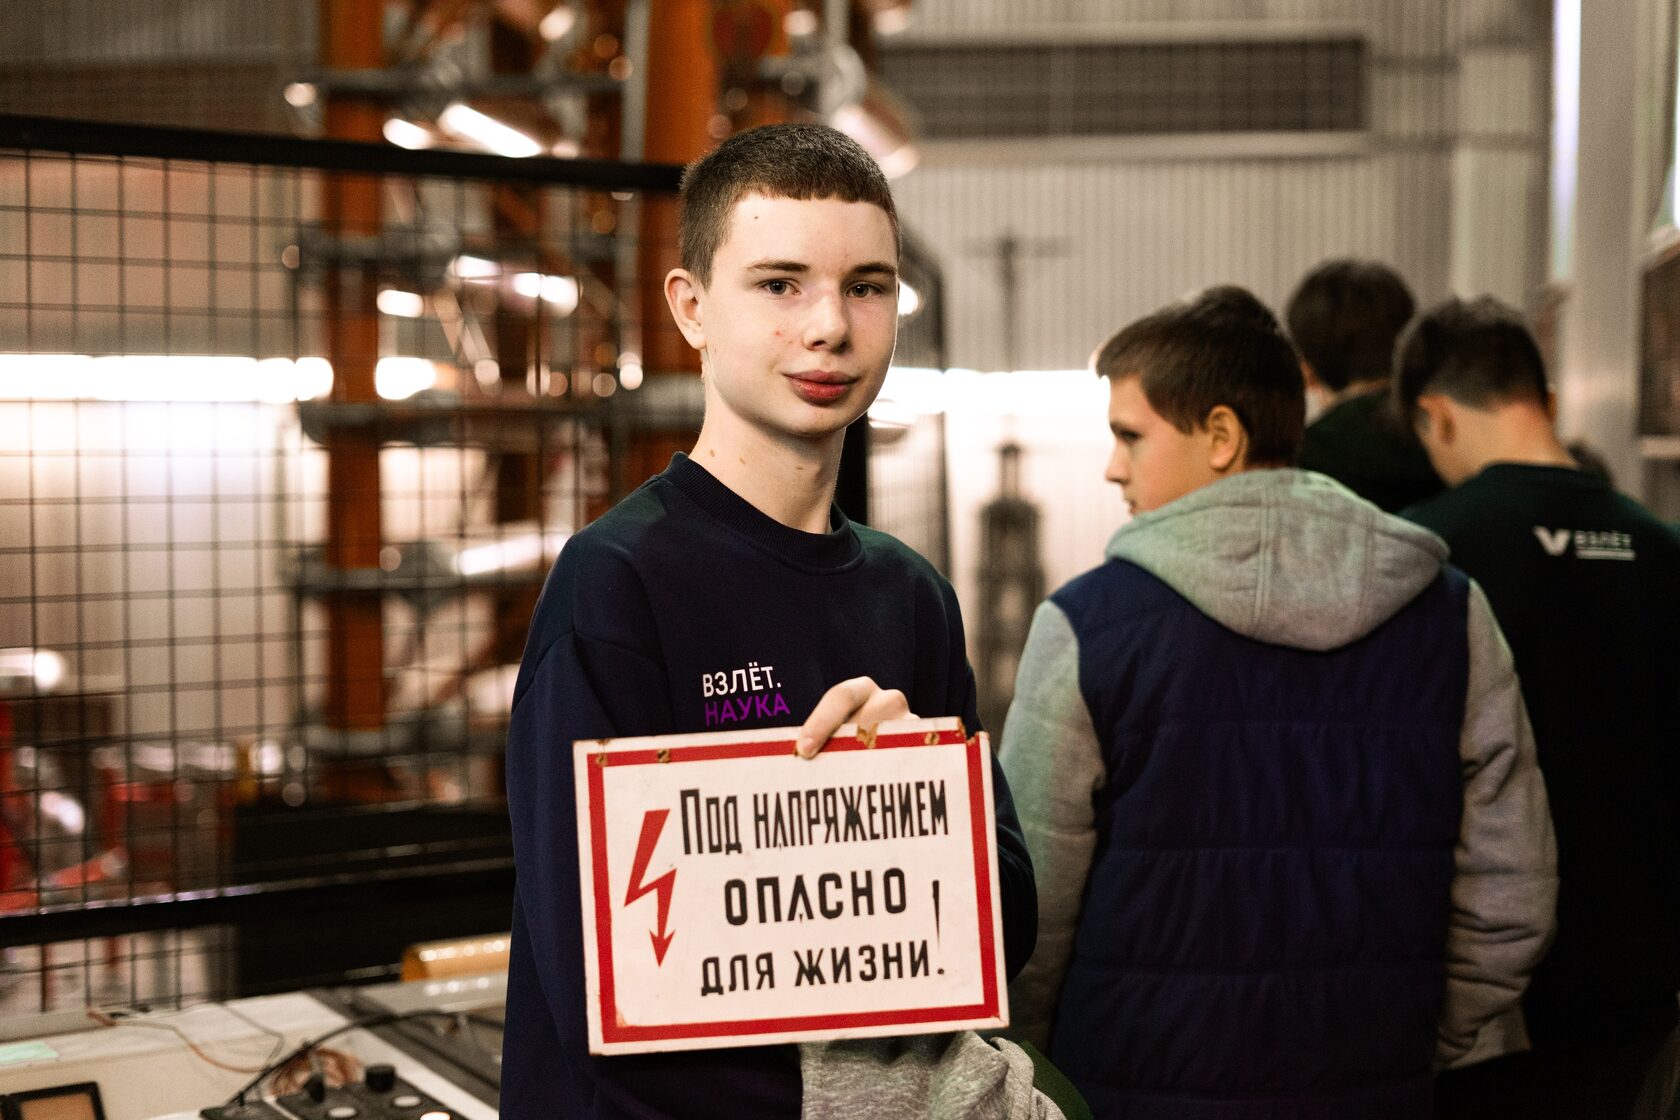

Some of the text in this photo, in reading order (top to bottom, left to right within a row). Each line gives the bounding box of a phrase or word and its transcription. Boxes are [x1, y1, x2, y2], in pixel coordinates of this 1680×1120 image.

[702, 661, 782, 698] ВЗЛЁТ.
[704, 692, 791, 727] НАУКА
[752, 779, 949, 850] НАПРЯЖЕНИЕМ
[723, 866, 908, 927] ОПАСНО
